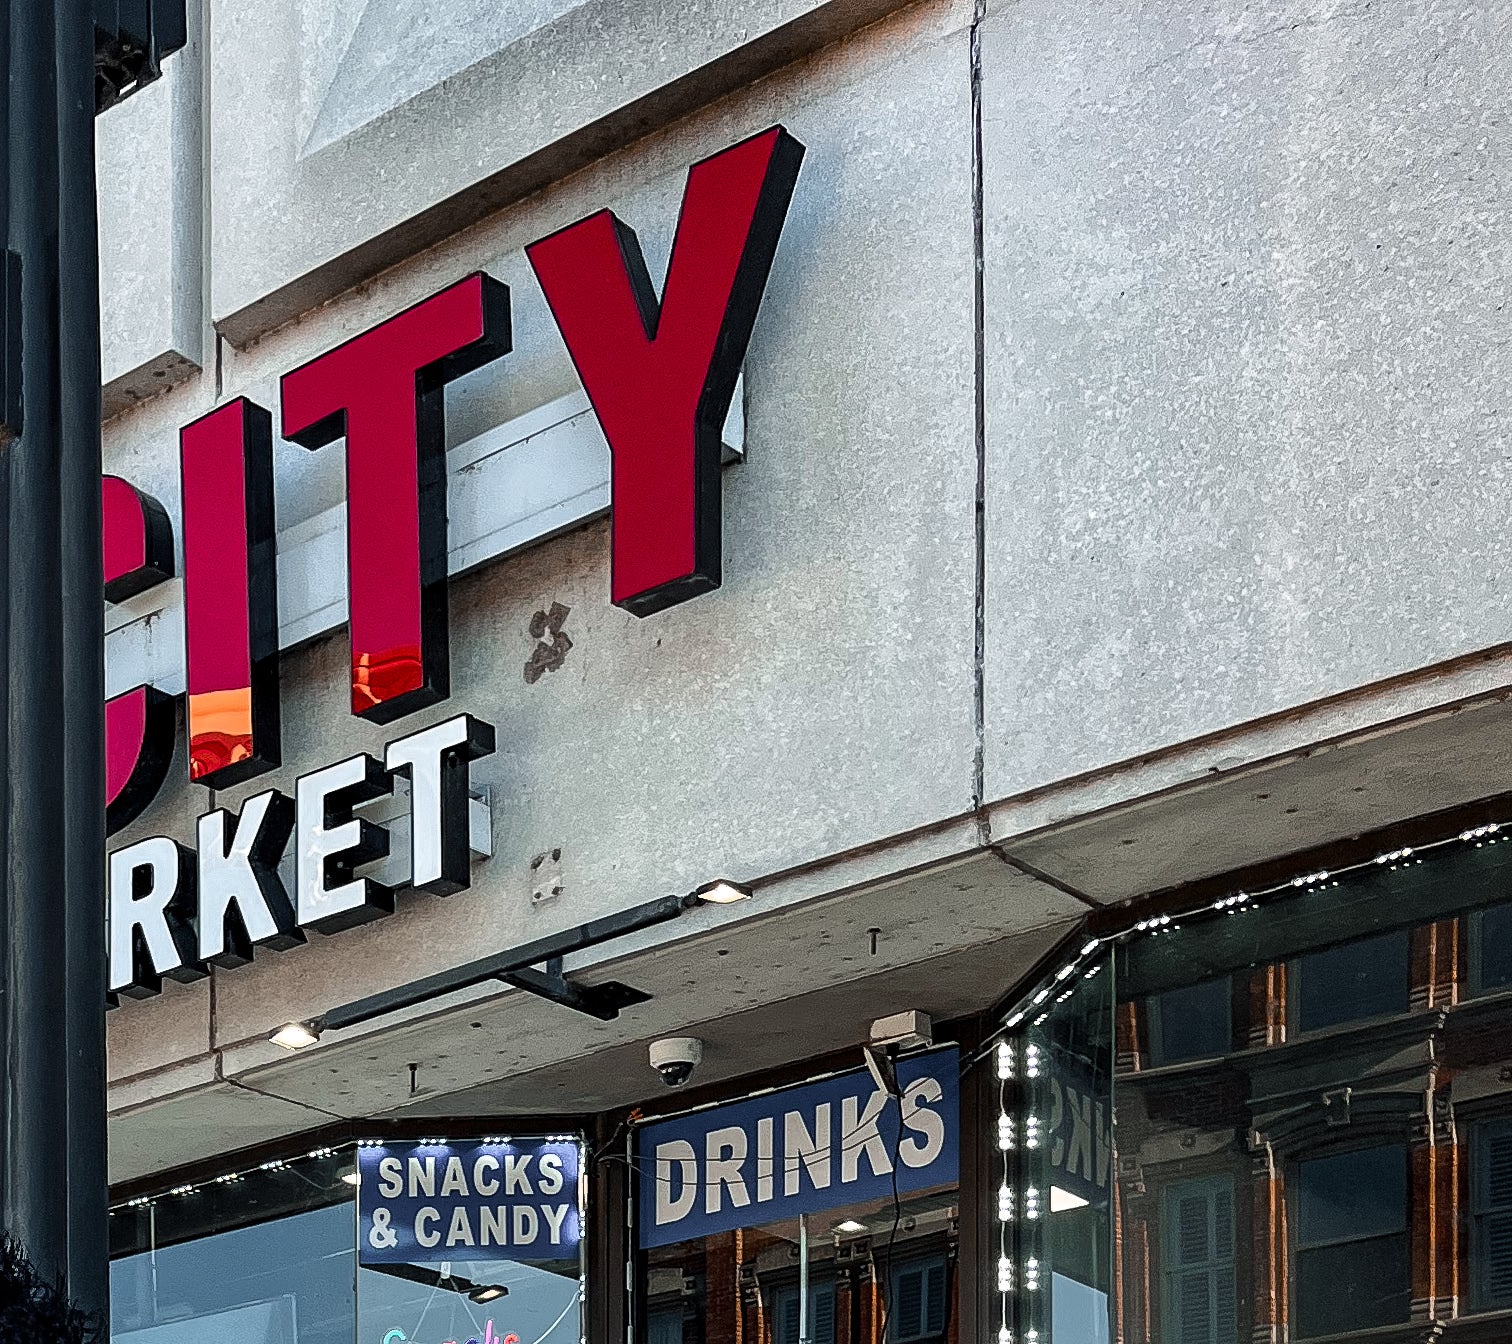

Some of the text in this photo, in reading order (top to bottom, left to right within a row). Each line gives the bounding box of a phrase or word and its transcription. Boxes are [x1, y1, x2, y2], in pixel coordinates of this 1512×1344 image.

[655, 1076, 945, 1226] DRINKS
[378, 1153, 565, 1199] SNACKS
[369, 1203, 570, 1249] & CANDY
